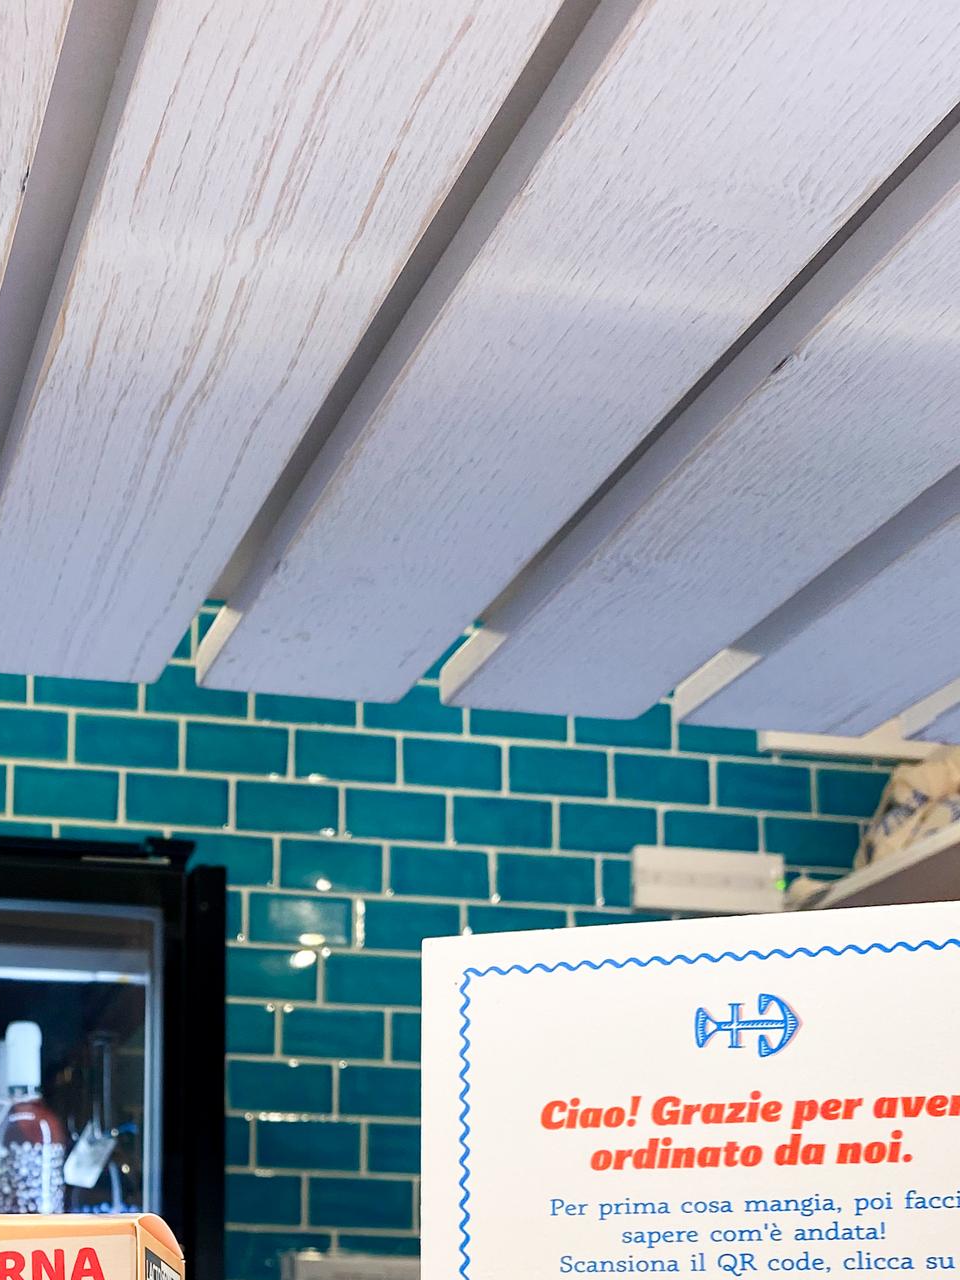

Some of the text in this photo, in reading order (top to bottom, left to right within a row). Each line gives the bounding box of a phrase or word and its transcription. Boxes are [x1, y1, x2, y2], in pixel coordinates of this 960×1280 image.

[541, 1096, 641, 1130] Ciao!
[651, 1091, 782, 1126] Grazie
[791, 1098, 863, 1129] per
[591, 1130, 912, 1171] ordinato da noi.
[550, 1199, 588, 1216] Per
[599, 1198, 671, 1220] prima
[681, 1201, 733, 1213] cosa
[745, 1194, 841, 1216] mangia,
[854, 1192, 893, 1216] poi
[622, 1221, 885, 1248] sapere com'è andata!
[560, 1251, 955, 1276] Scansiona il QR code, clicca su
